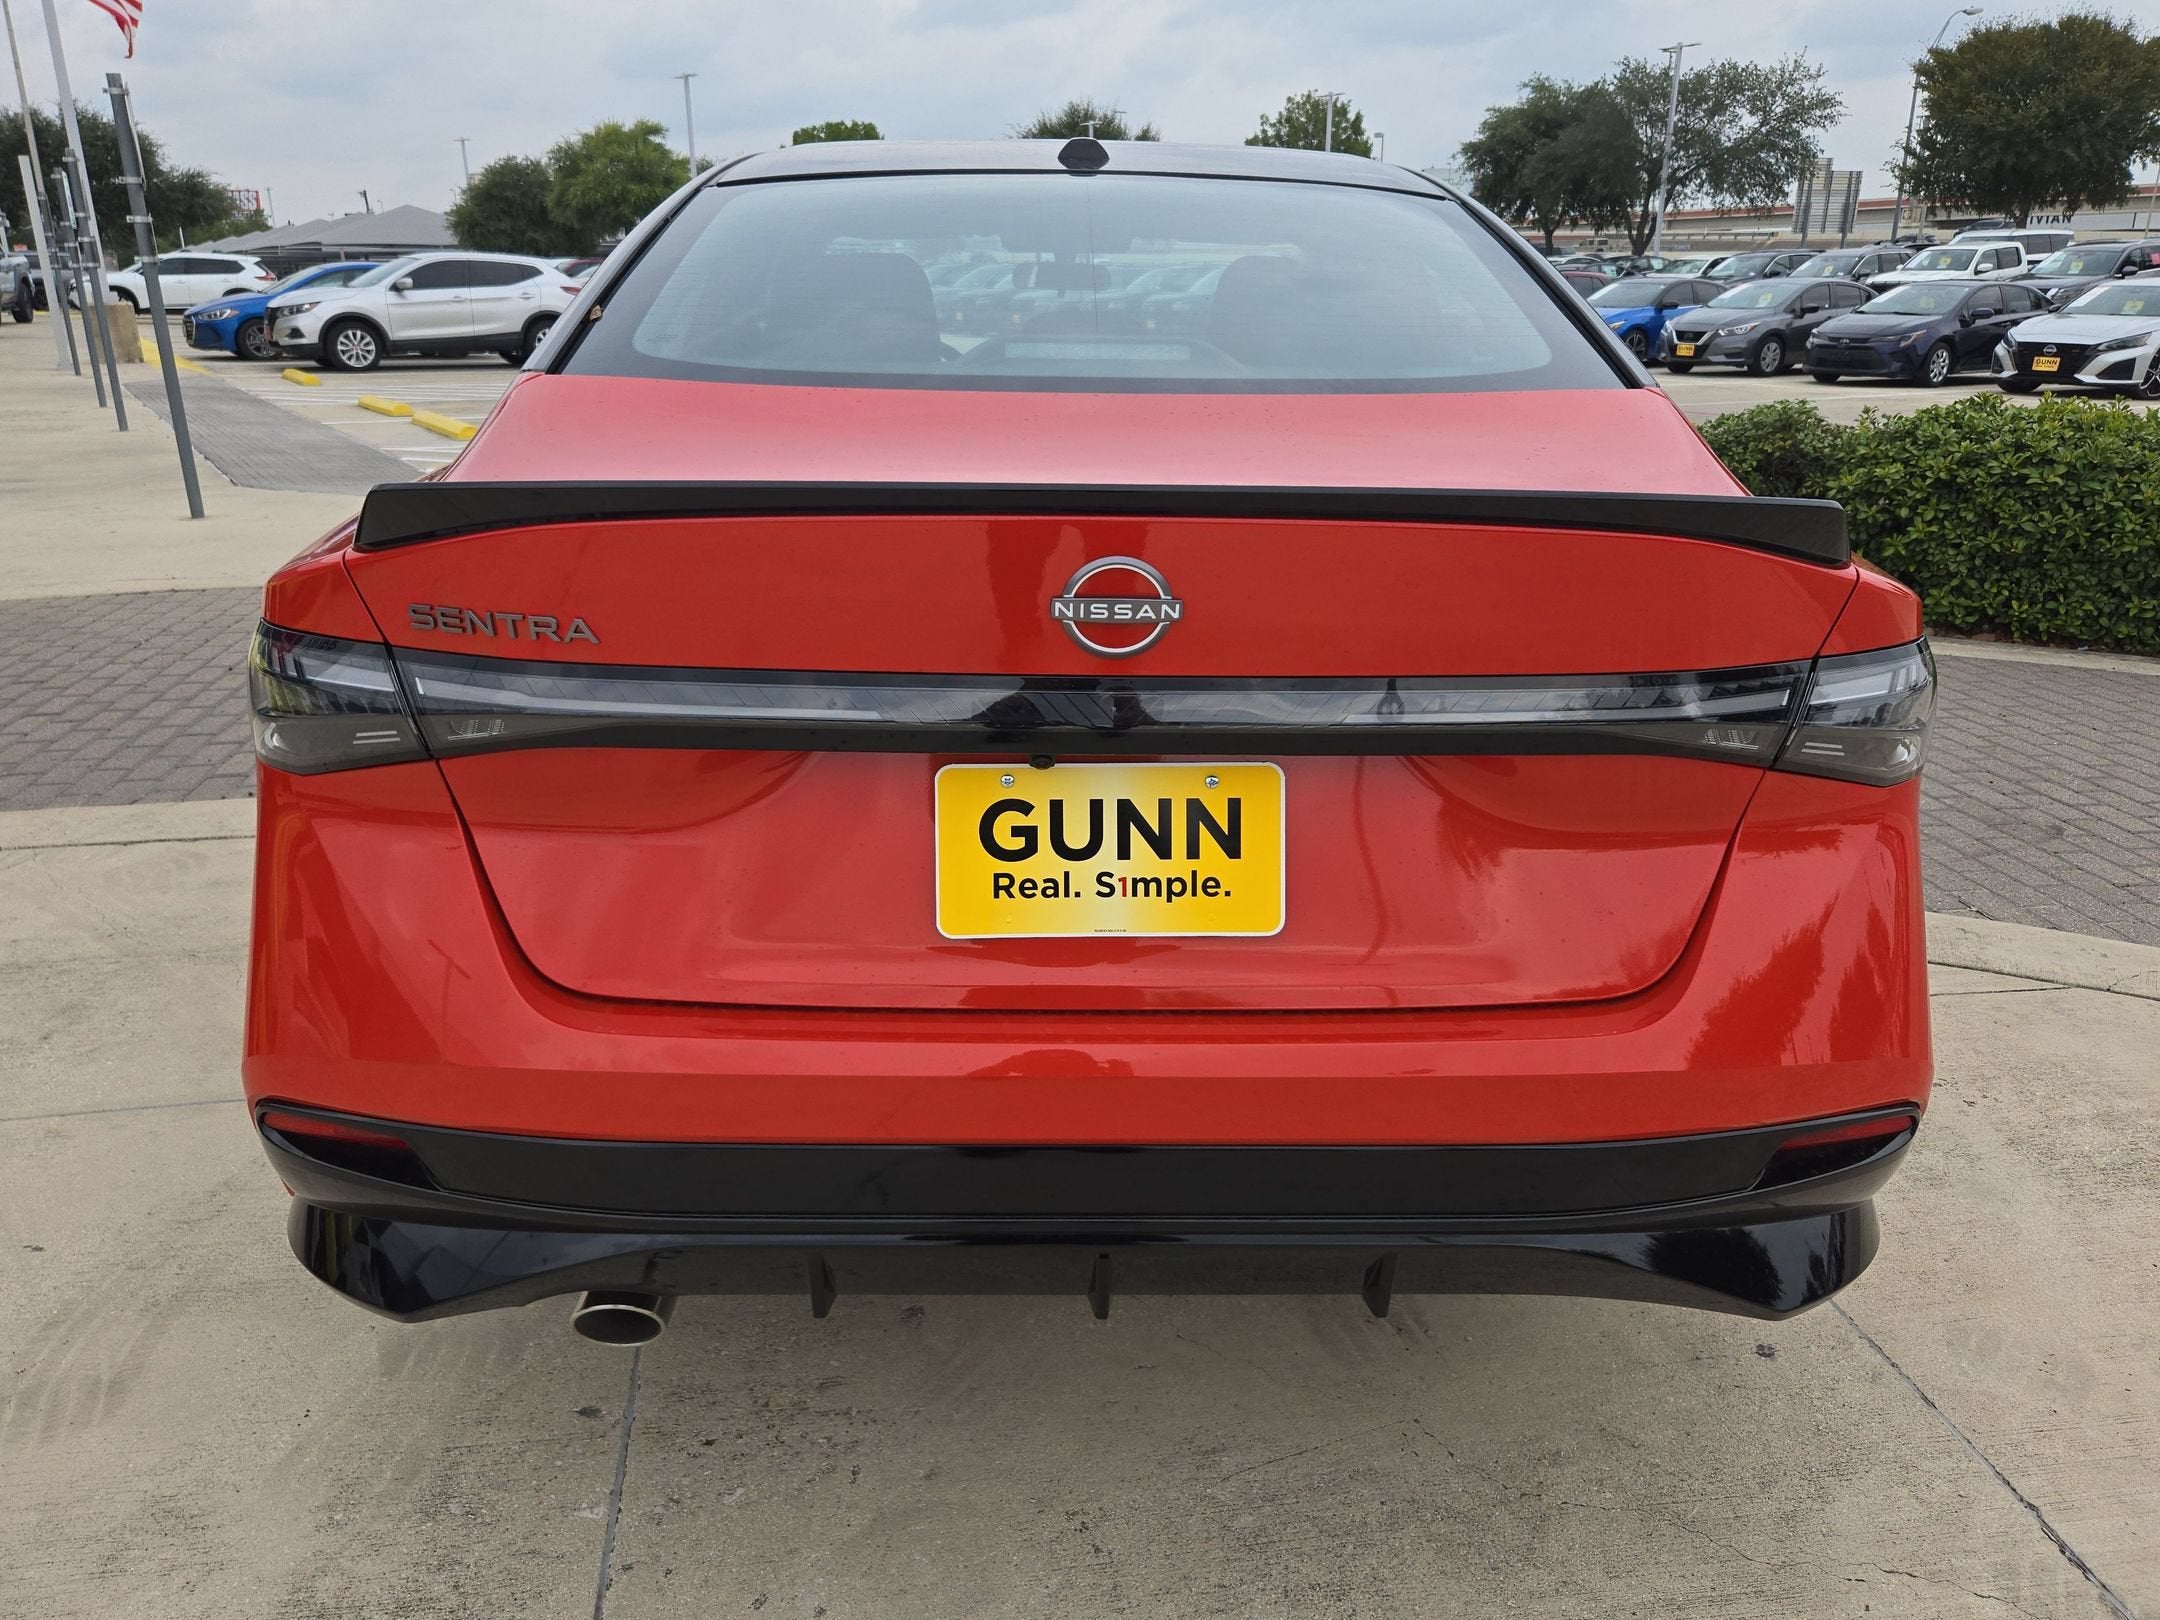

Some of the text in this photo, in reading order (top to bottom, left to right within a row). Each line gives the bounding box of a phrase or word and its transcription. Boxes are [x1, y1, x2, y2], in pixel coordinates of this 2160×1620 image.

[2028, 214, 2072, 225] IVIAN
[408, 603, 601, 644] SENTRA
[1054, 602, 1180, 619] NISSAN
[978, 797, 1242, 862] GUNN
[992, 870, 1081, 899] Real.
